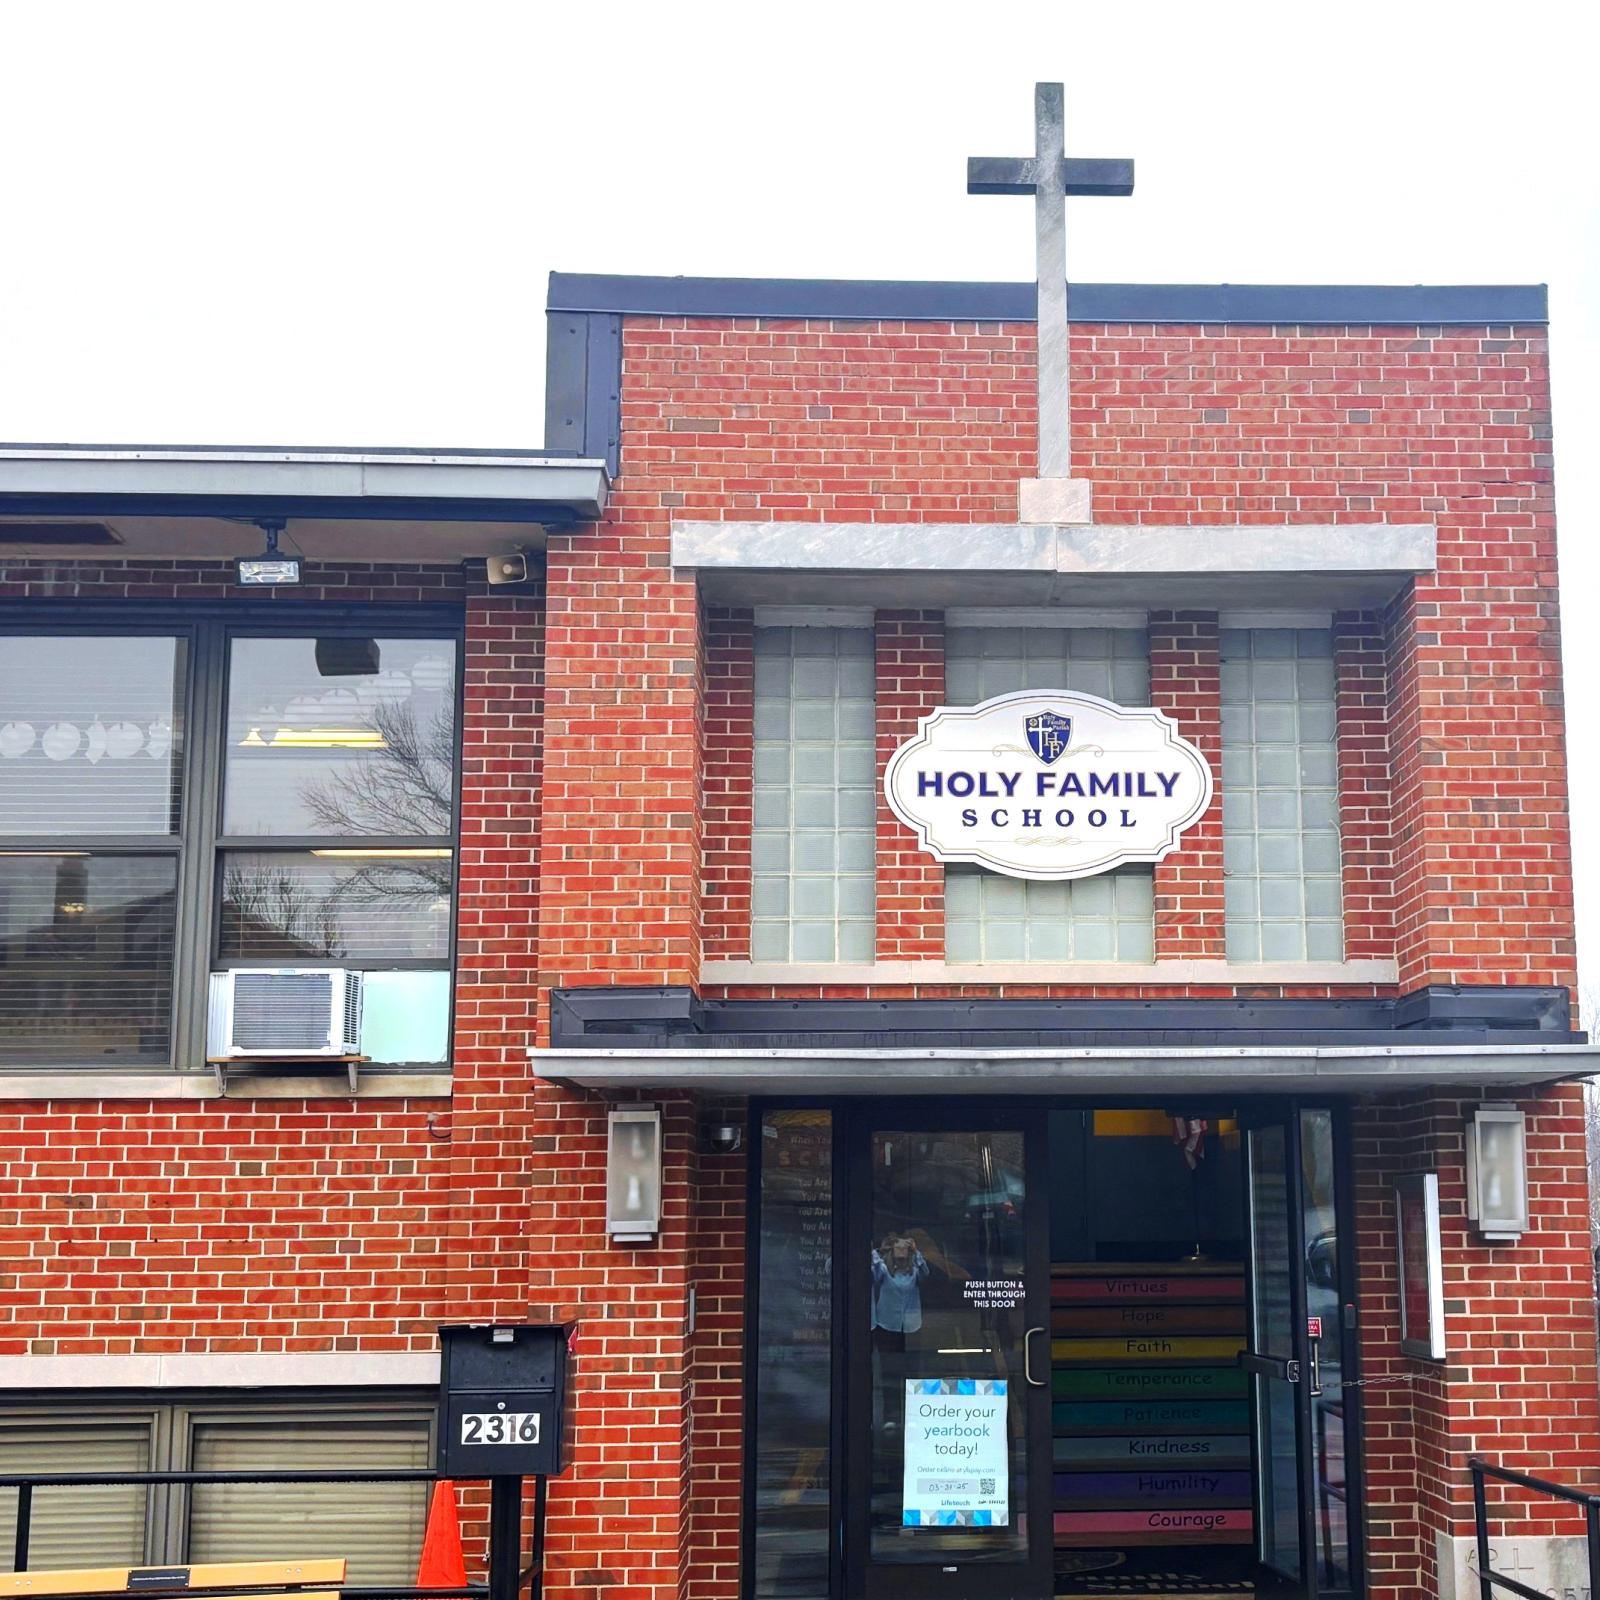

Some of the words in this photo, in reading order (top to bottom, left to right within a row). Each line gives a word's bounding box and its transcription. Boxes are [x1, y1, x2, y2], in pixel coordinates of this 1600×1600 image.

[917, 771, 1023, 798] HOLY
[1036, 771, 1181, 798] FAMILY
[962, 808, 1137, 828] SCHOOL
[965, 1280, 985, 1288] PUSH
[987, 1280, 1016, 1288] BUTTON
[1105, 1280, 1168, 1293] Virtues
[963, 1290, 986, 1298] ENTER
[987, 1290, 1026, 1298] THROUGH
[973, 1300, 990, 1308] THIS
[991, 1300, 1016, 1308] DOOR
[1121, 1310, 1165, 1325] Hope
[1126, 1340, 1172, 1353] Faith
[1103, 1372, 1213, 1388] Temperance
[919, 1404, 961, 1418] Order
[964, 1408, 997, 1421] your
[1123, 1407, 1201, 1421] Patience
[464, 1414, 538, 1443] 2316
[924, 1424, 990, 1440] yearbook
[935, 1442, 978, 1458] today!
[1129, 1440, 1210, 1454] Kindness
[1138, 1475, 1220, 1492] Humility
[941, 1499, 970, 1507] Lifetouch
[1148, 1513, 1226, 1529] Courage
